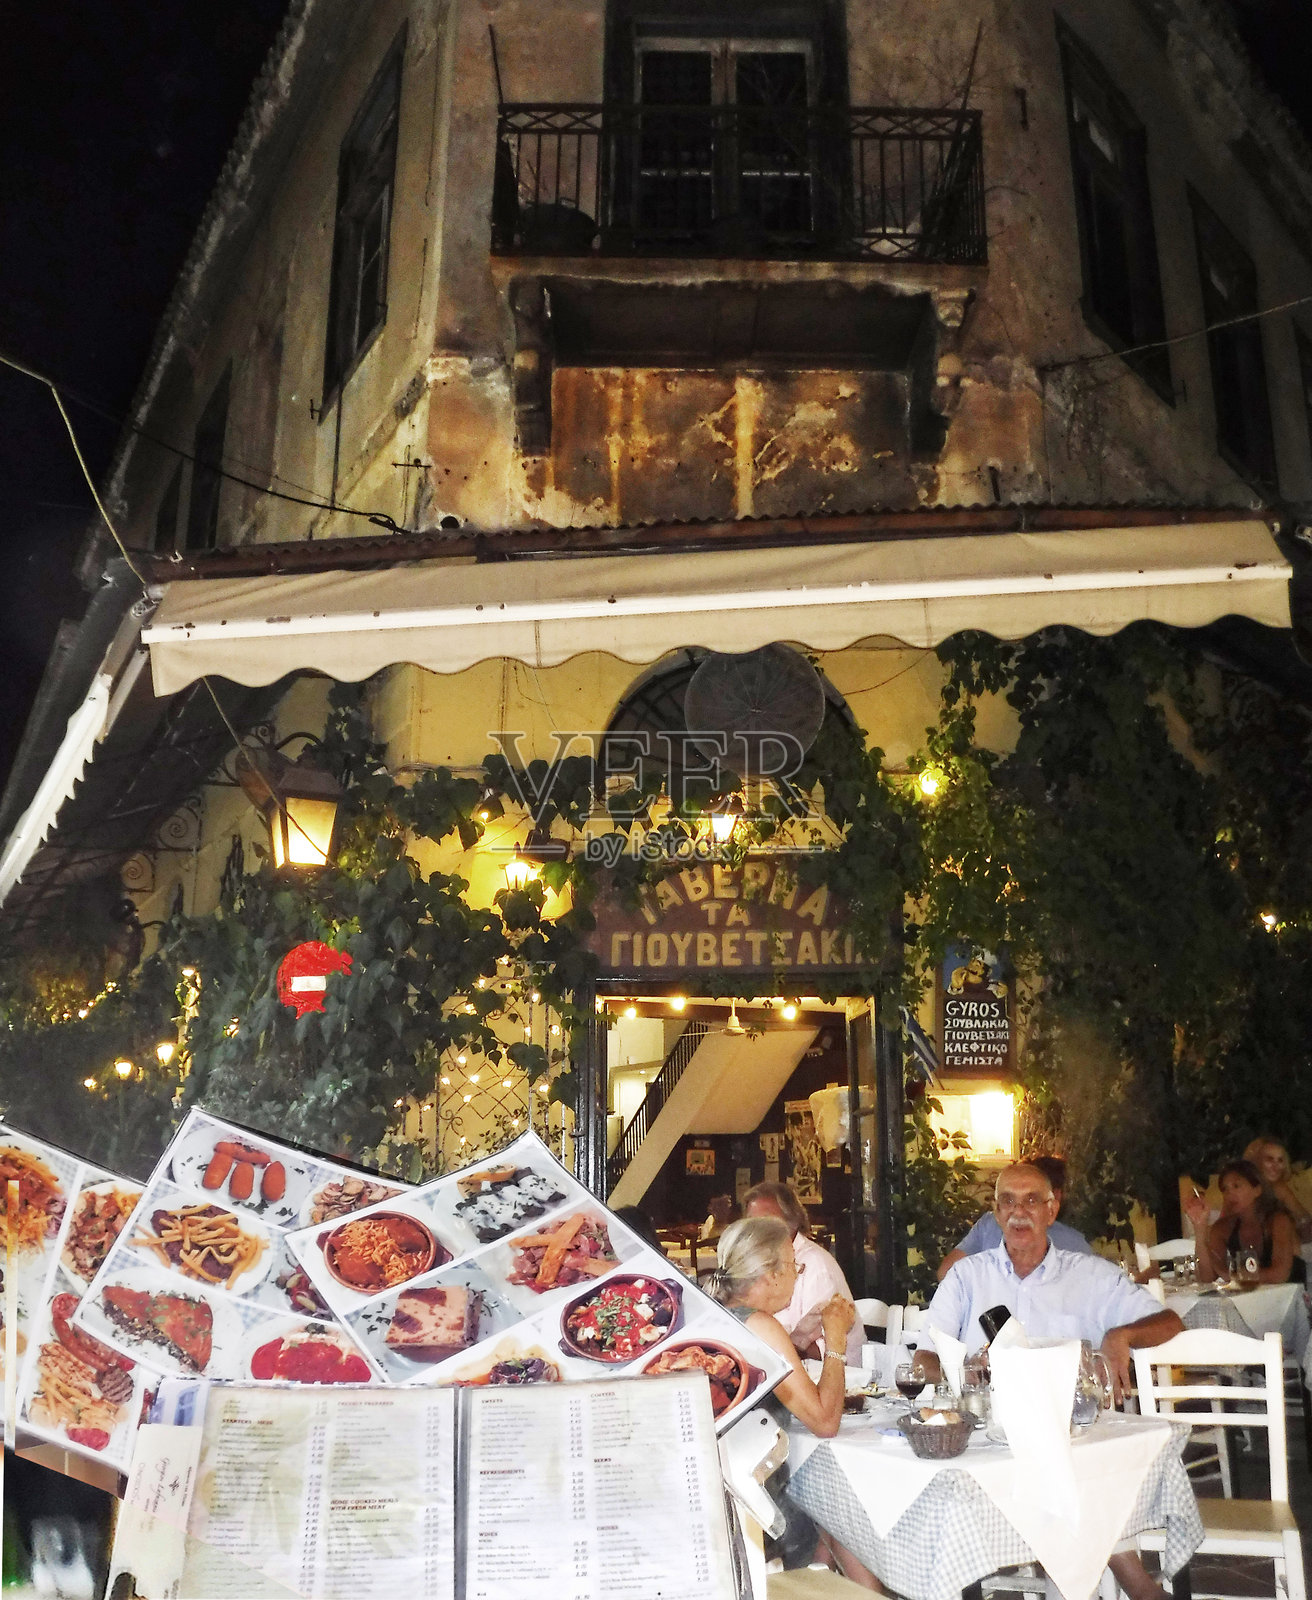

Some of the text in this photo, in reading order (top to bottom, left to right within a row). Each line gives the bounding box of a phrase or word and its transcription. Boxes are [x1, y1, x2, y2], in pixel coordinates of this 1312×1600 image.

[700, 901, 751, 926] ΤΑ
[945, 1000, 1000, 1018] GYROS
[944, 1017, 1009, 1029] ΣΟΥΒΛΑΚΙΑ
[944, 1042, 1008, 1055] ΚΛΕΦΤΙΚΟ
[945, 1055, 1003, 1066] ΓΕΜΙΣΤΑ
